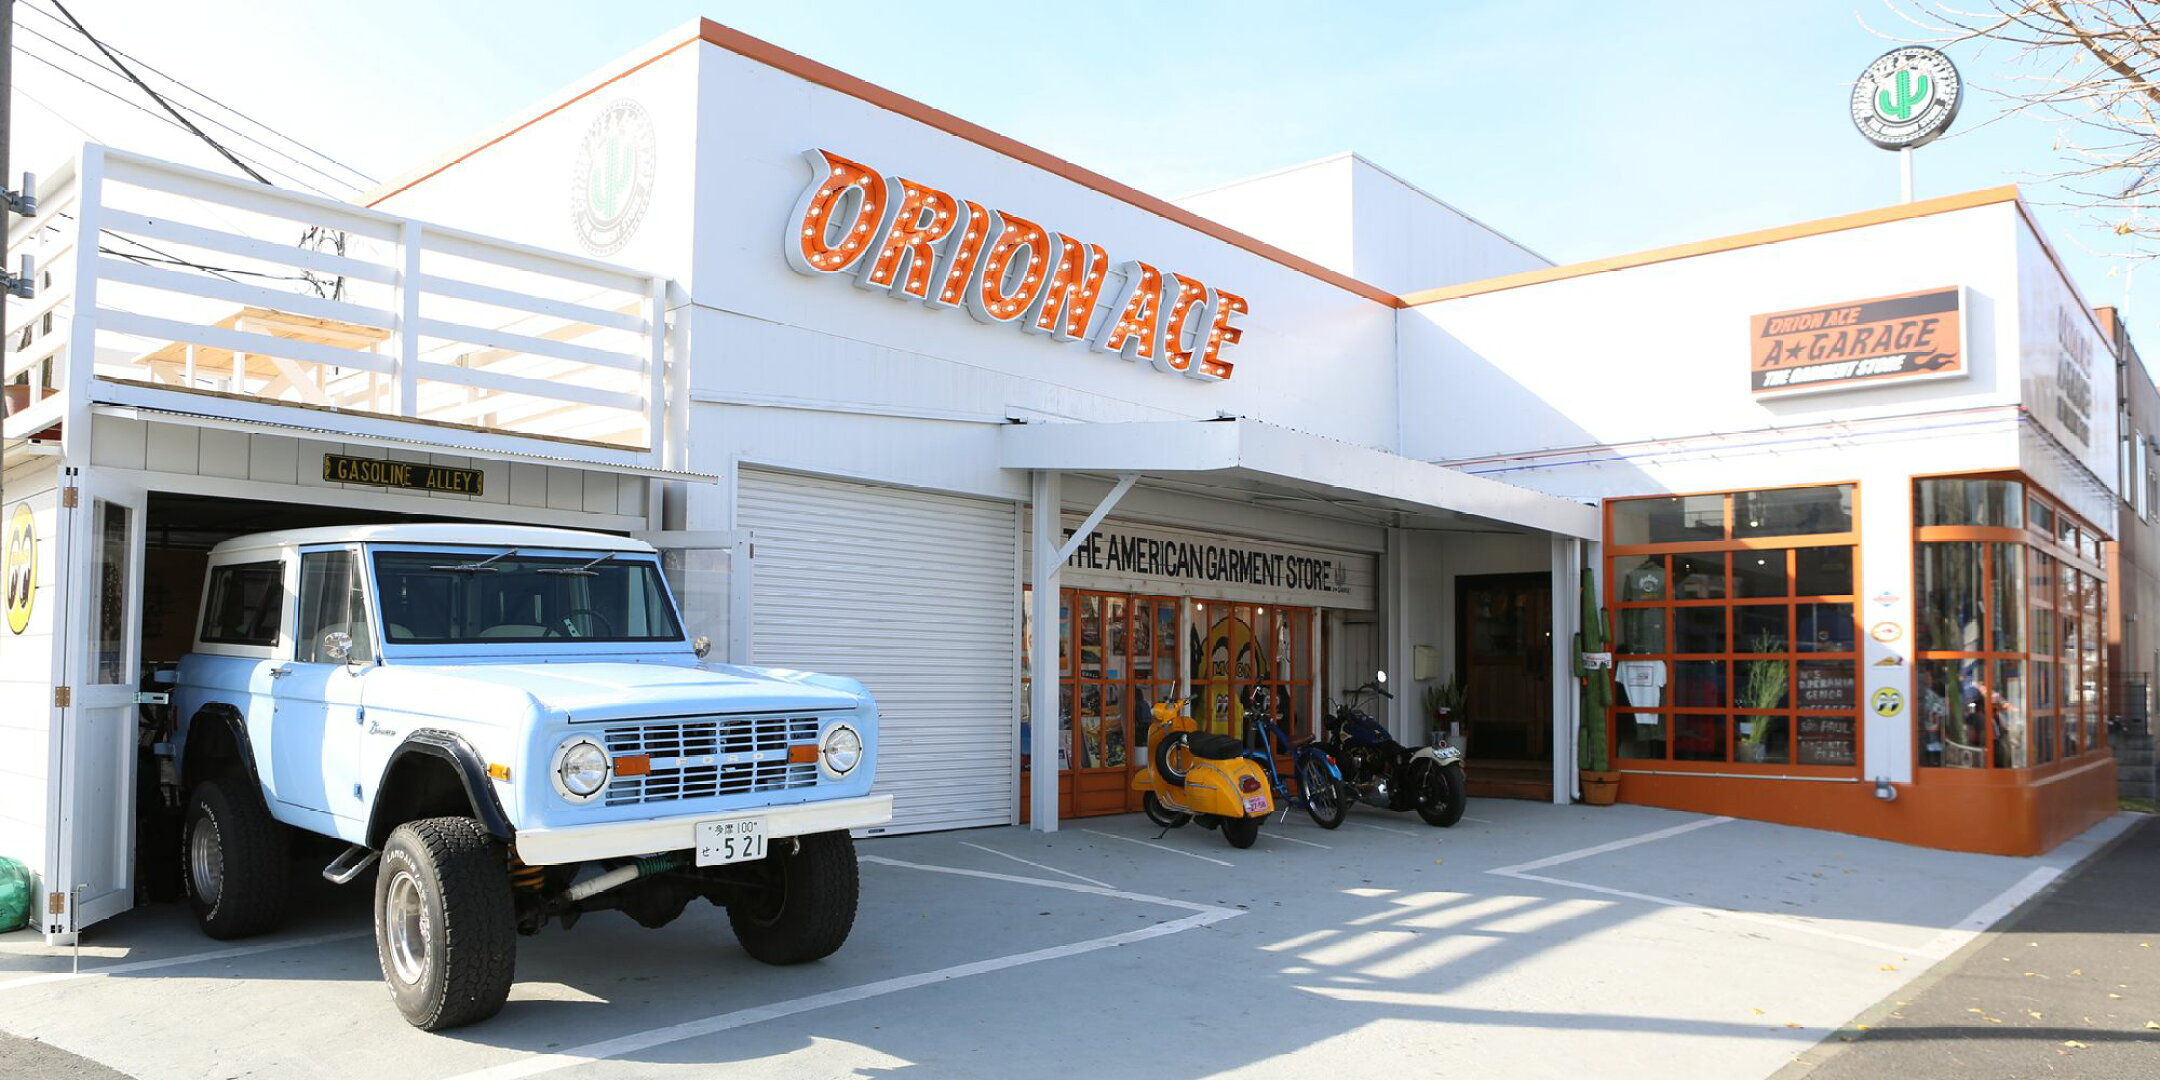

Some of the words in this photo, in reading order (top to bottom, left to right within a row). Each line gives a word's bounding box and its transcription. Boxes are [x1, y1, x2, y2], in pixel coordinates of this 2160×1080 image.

[790, 148, 1108, 341] ORION
[1100, 260, 1249, 381] ACE
[1769, 311, 1824, 335] ORION
[1825, 307, 1862, 327] ACE
[1809, 318, 1940, 361] GARAGE
[1763, 368, 1792, 387] THE
[1857, 354, 1907, 376] STORE
[338, 459, 413, 486] GASOLINE
[426, 468, 473, 492] ALLEY
[1063, 528, 1103, 569] THE
[1106, 534, 1203, 579] AMERICAN
[1206, 545, 1284, 587] GARMENT
[1286, 554, 1332, 591] STORE
[676, 752, 764, 766] FORD
